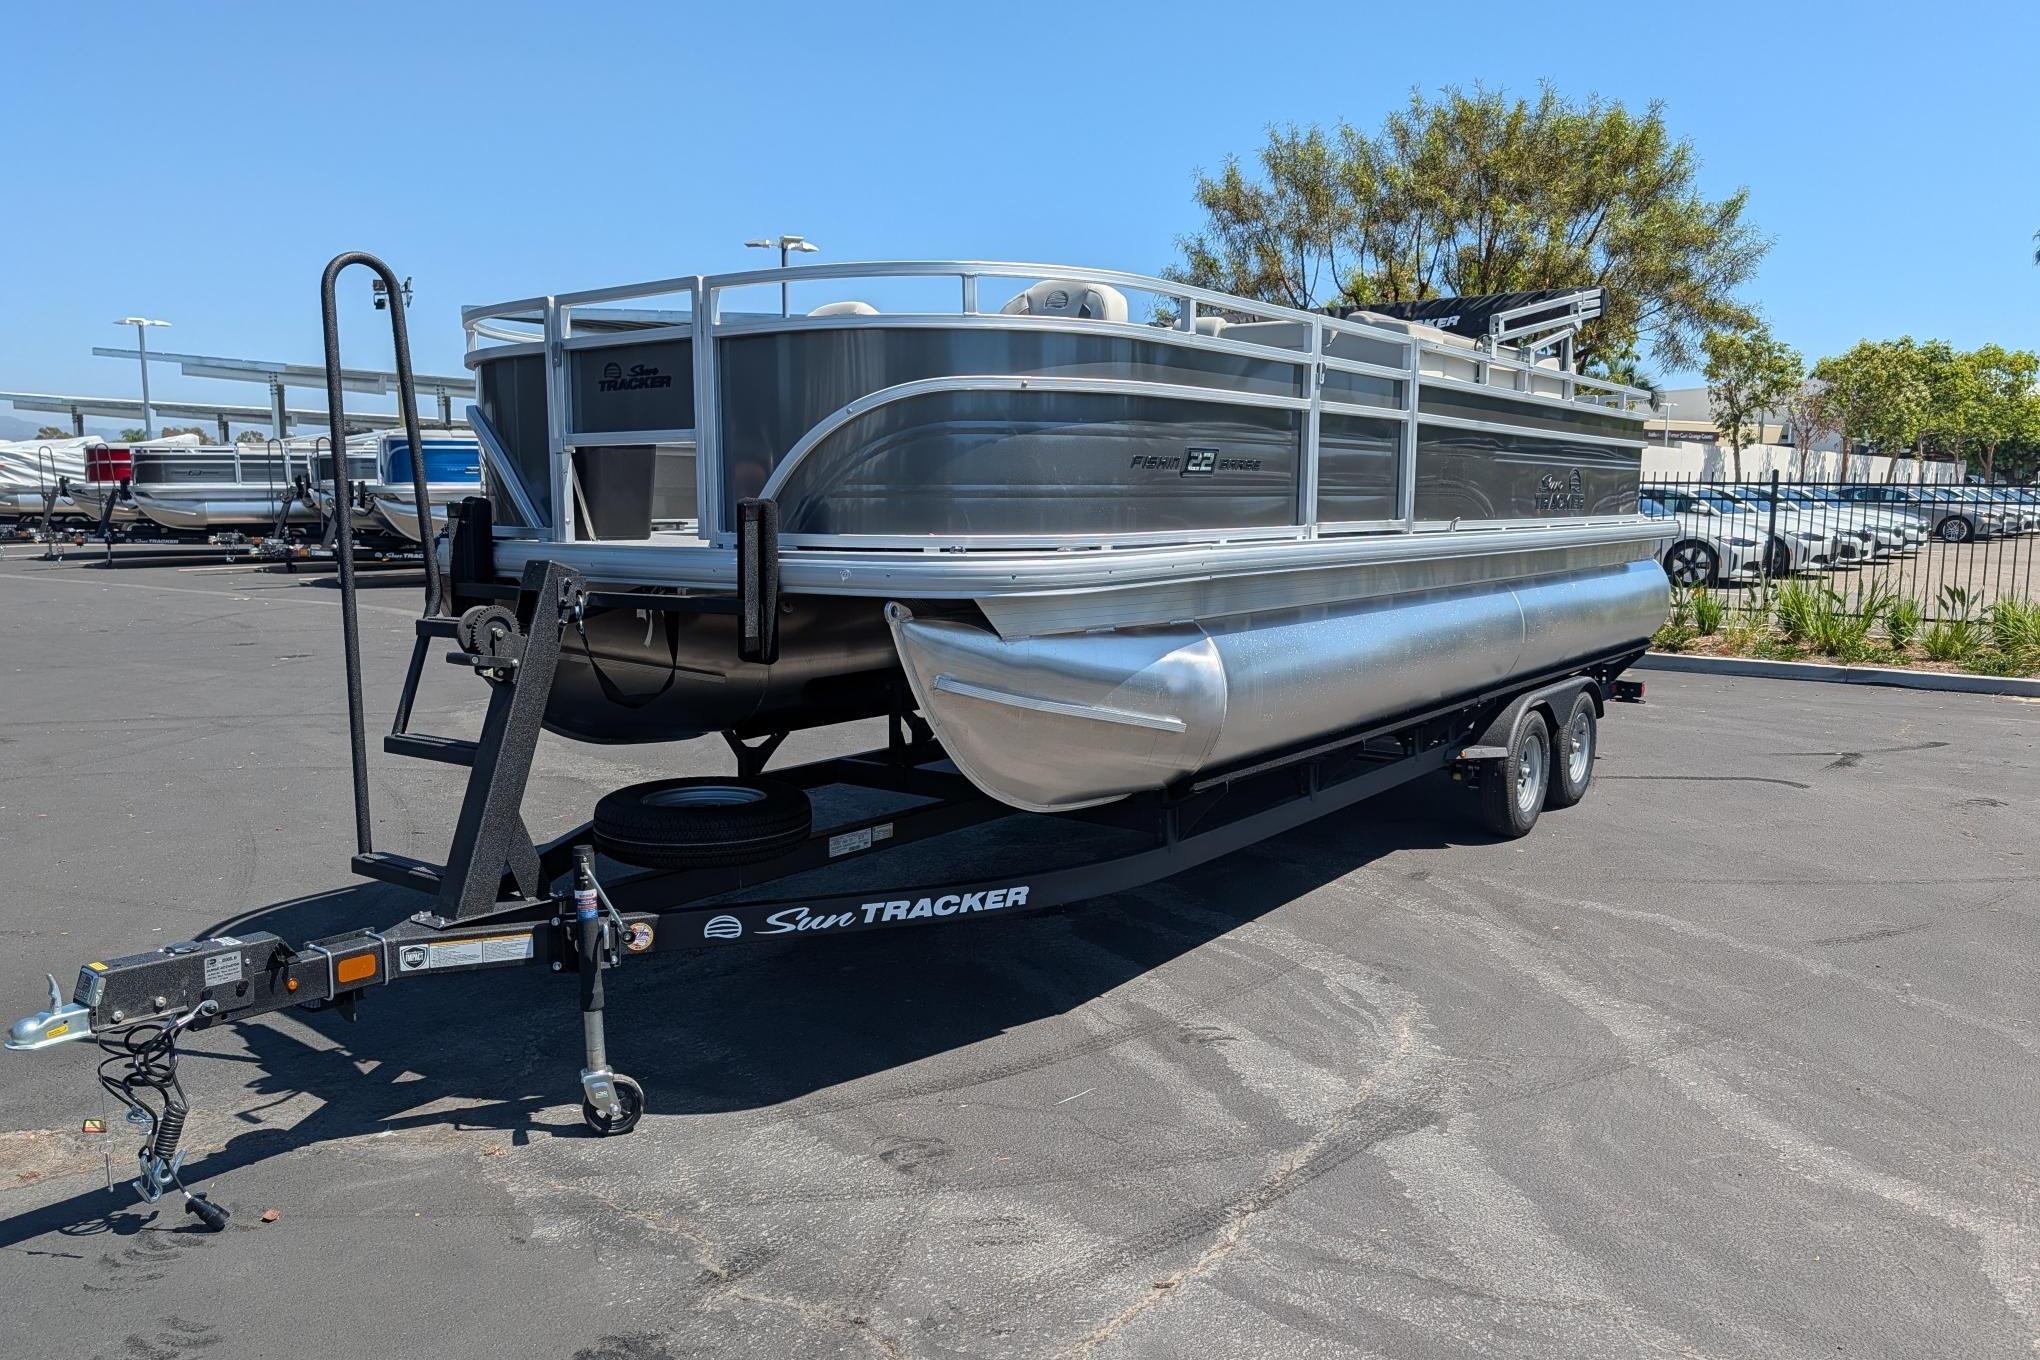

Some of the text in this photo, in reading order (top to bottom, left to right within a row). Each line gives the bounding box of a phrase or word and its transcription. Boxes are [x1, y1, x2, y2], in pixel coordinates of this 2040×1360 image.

[627, 364, 659, 377] Sun
[598, 375, 672, 392] TRACKER
[1187, 452, 1215, 471] 22
[1535, 493, 1584, 510] TRACKER
[753, 886, 1031, 934] Sun TRACKER
